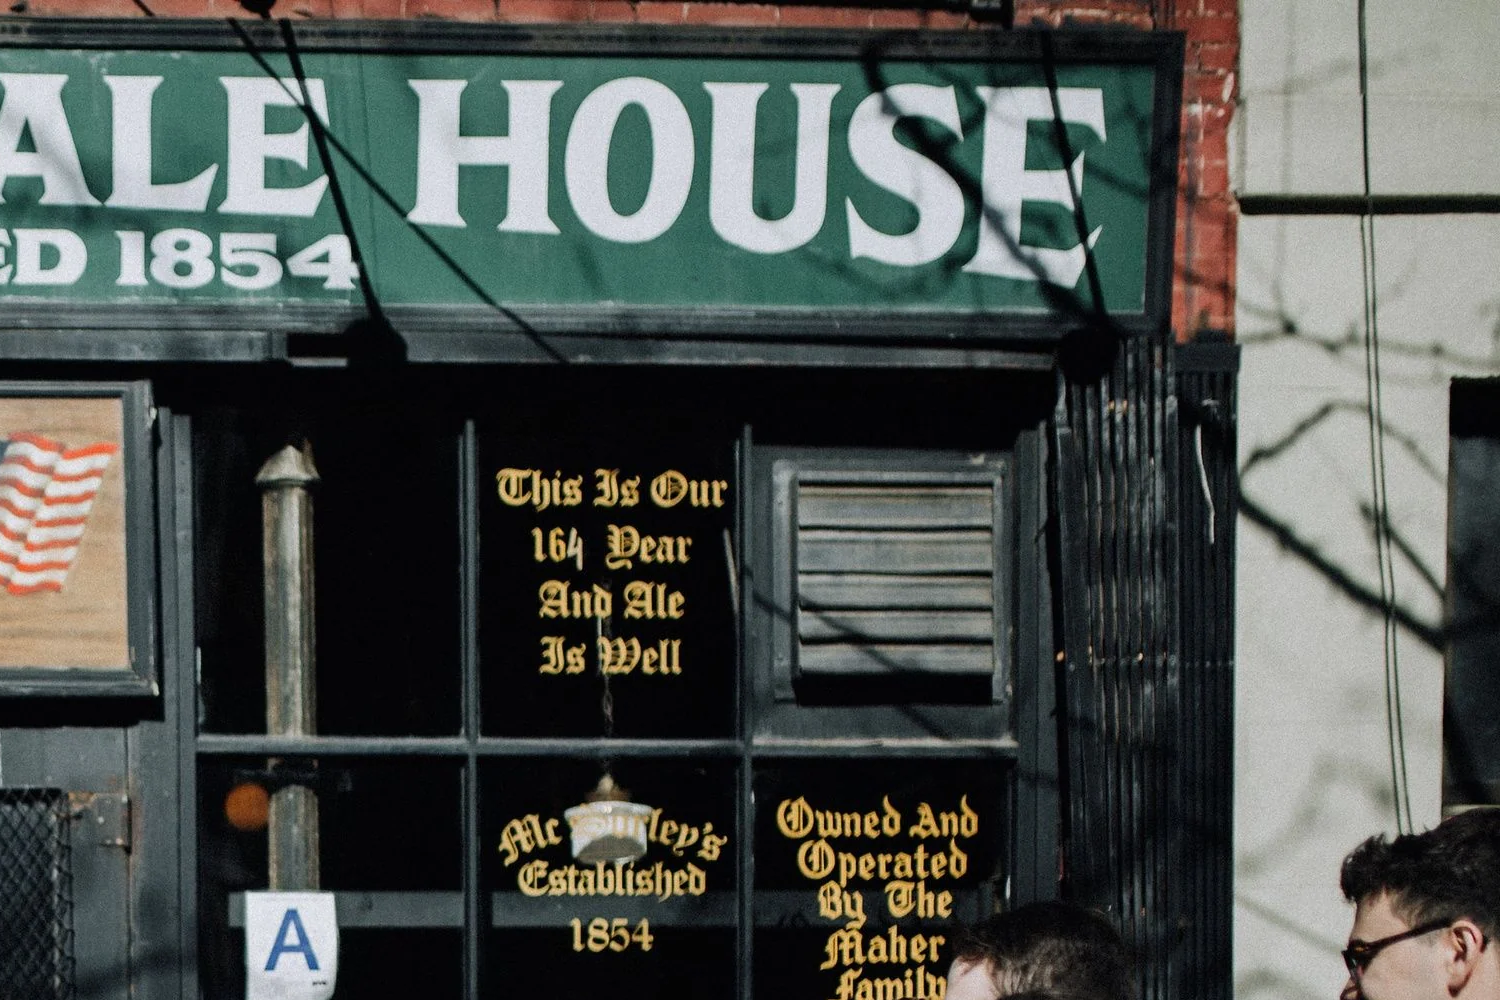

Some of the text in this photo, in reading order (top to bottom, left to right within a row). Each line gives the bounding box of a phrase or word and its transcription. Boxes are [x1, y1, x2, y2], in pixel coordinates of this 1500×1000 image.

[407, 76, 1106, 289] HOUSE
[115, 228, 360, 291] 1854
[495, 467, 728, 512] This Is Our
[531, 524, 693, 571] 164 Year
[538, 579, 685, 619] And Ale
[538, 636, 682, 675] Is Well
[776, 794, 979, 839] Owned And
[518, 859, 706, 903] Established
[796, 837, 968, 888] Operated
[817, 879, 953, 930] By The
[264, 908, 320, 971] A
[569, 917, 653, 952] 1854
[819, 924, 946, 970] Maher
